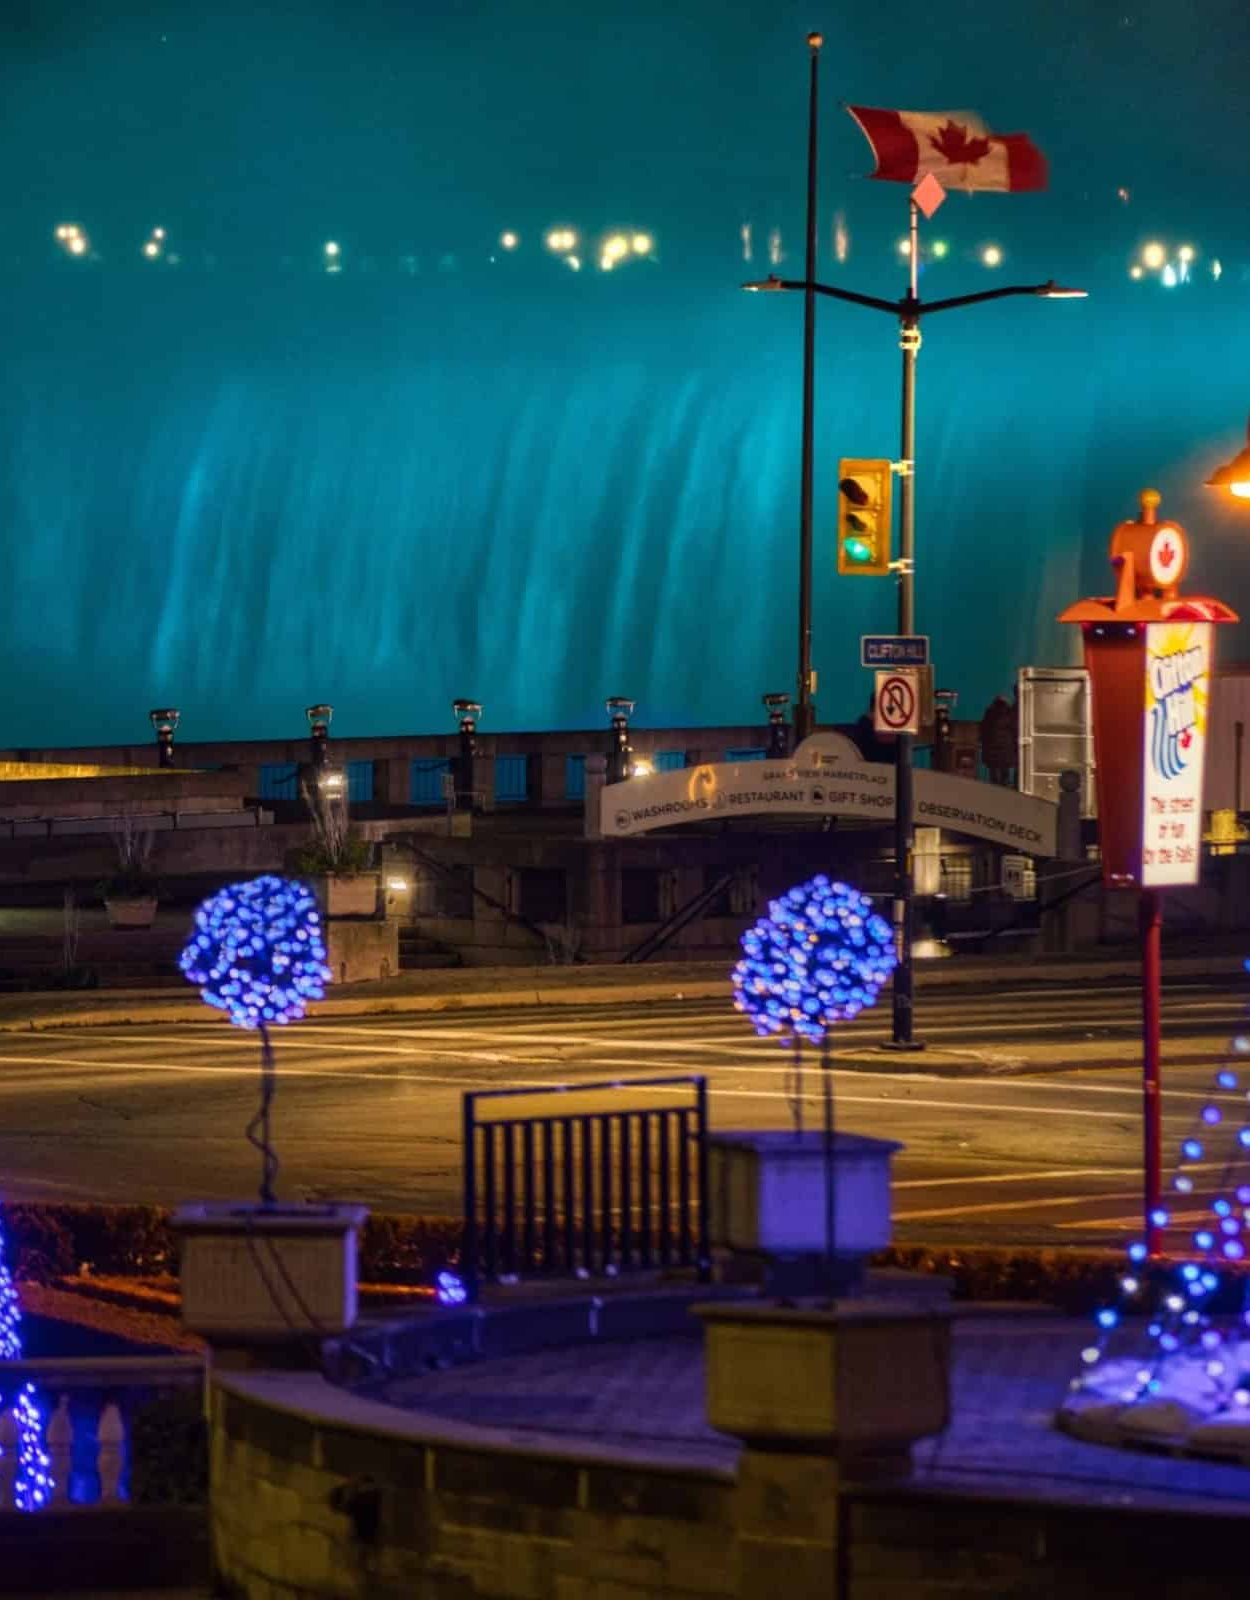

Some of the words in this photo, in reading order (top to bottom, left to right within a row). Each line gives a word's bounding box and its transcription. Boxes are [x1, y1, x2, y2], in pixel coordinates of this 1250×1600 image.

[868, 644, 905, 658] CLIFTON
[631, 799, 707, 821] WASHROOMS
[729, 791, 806, 805] RESTAURANT
[829, 790, 855, 803] GIFT
[860, 793, 894, 808] SHOP
[918, 801, 1006, 832] OBSERVATION
[1008, 824, 1043, 843] DECK
